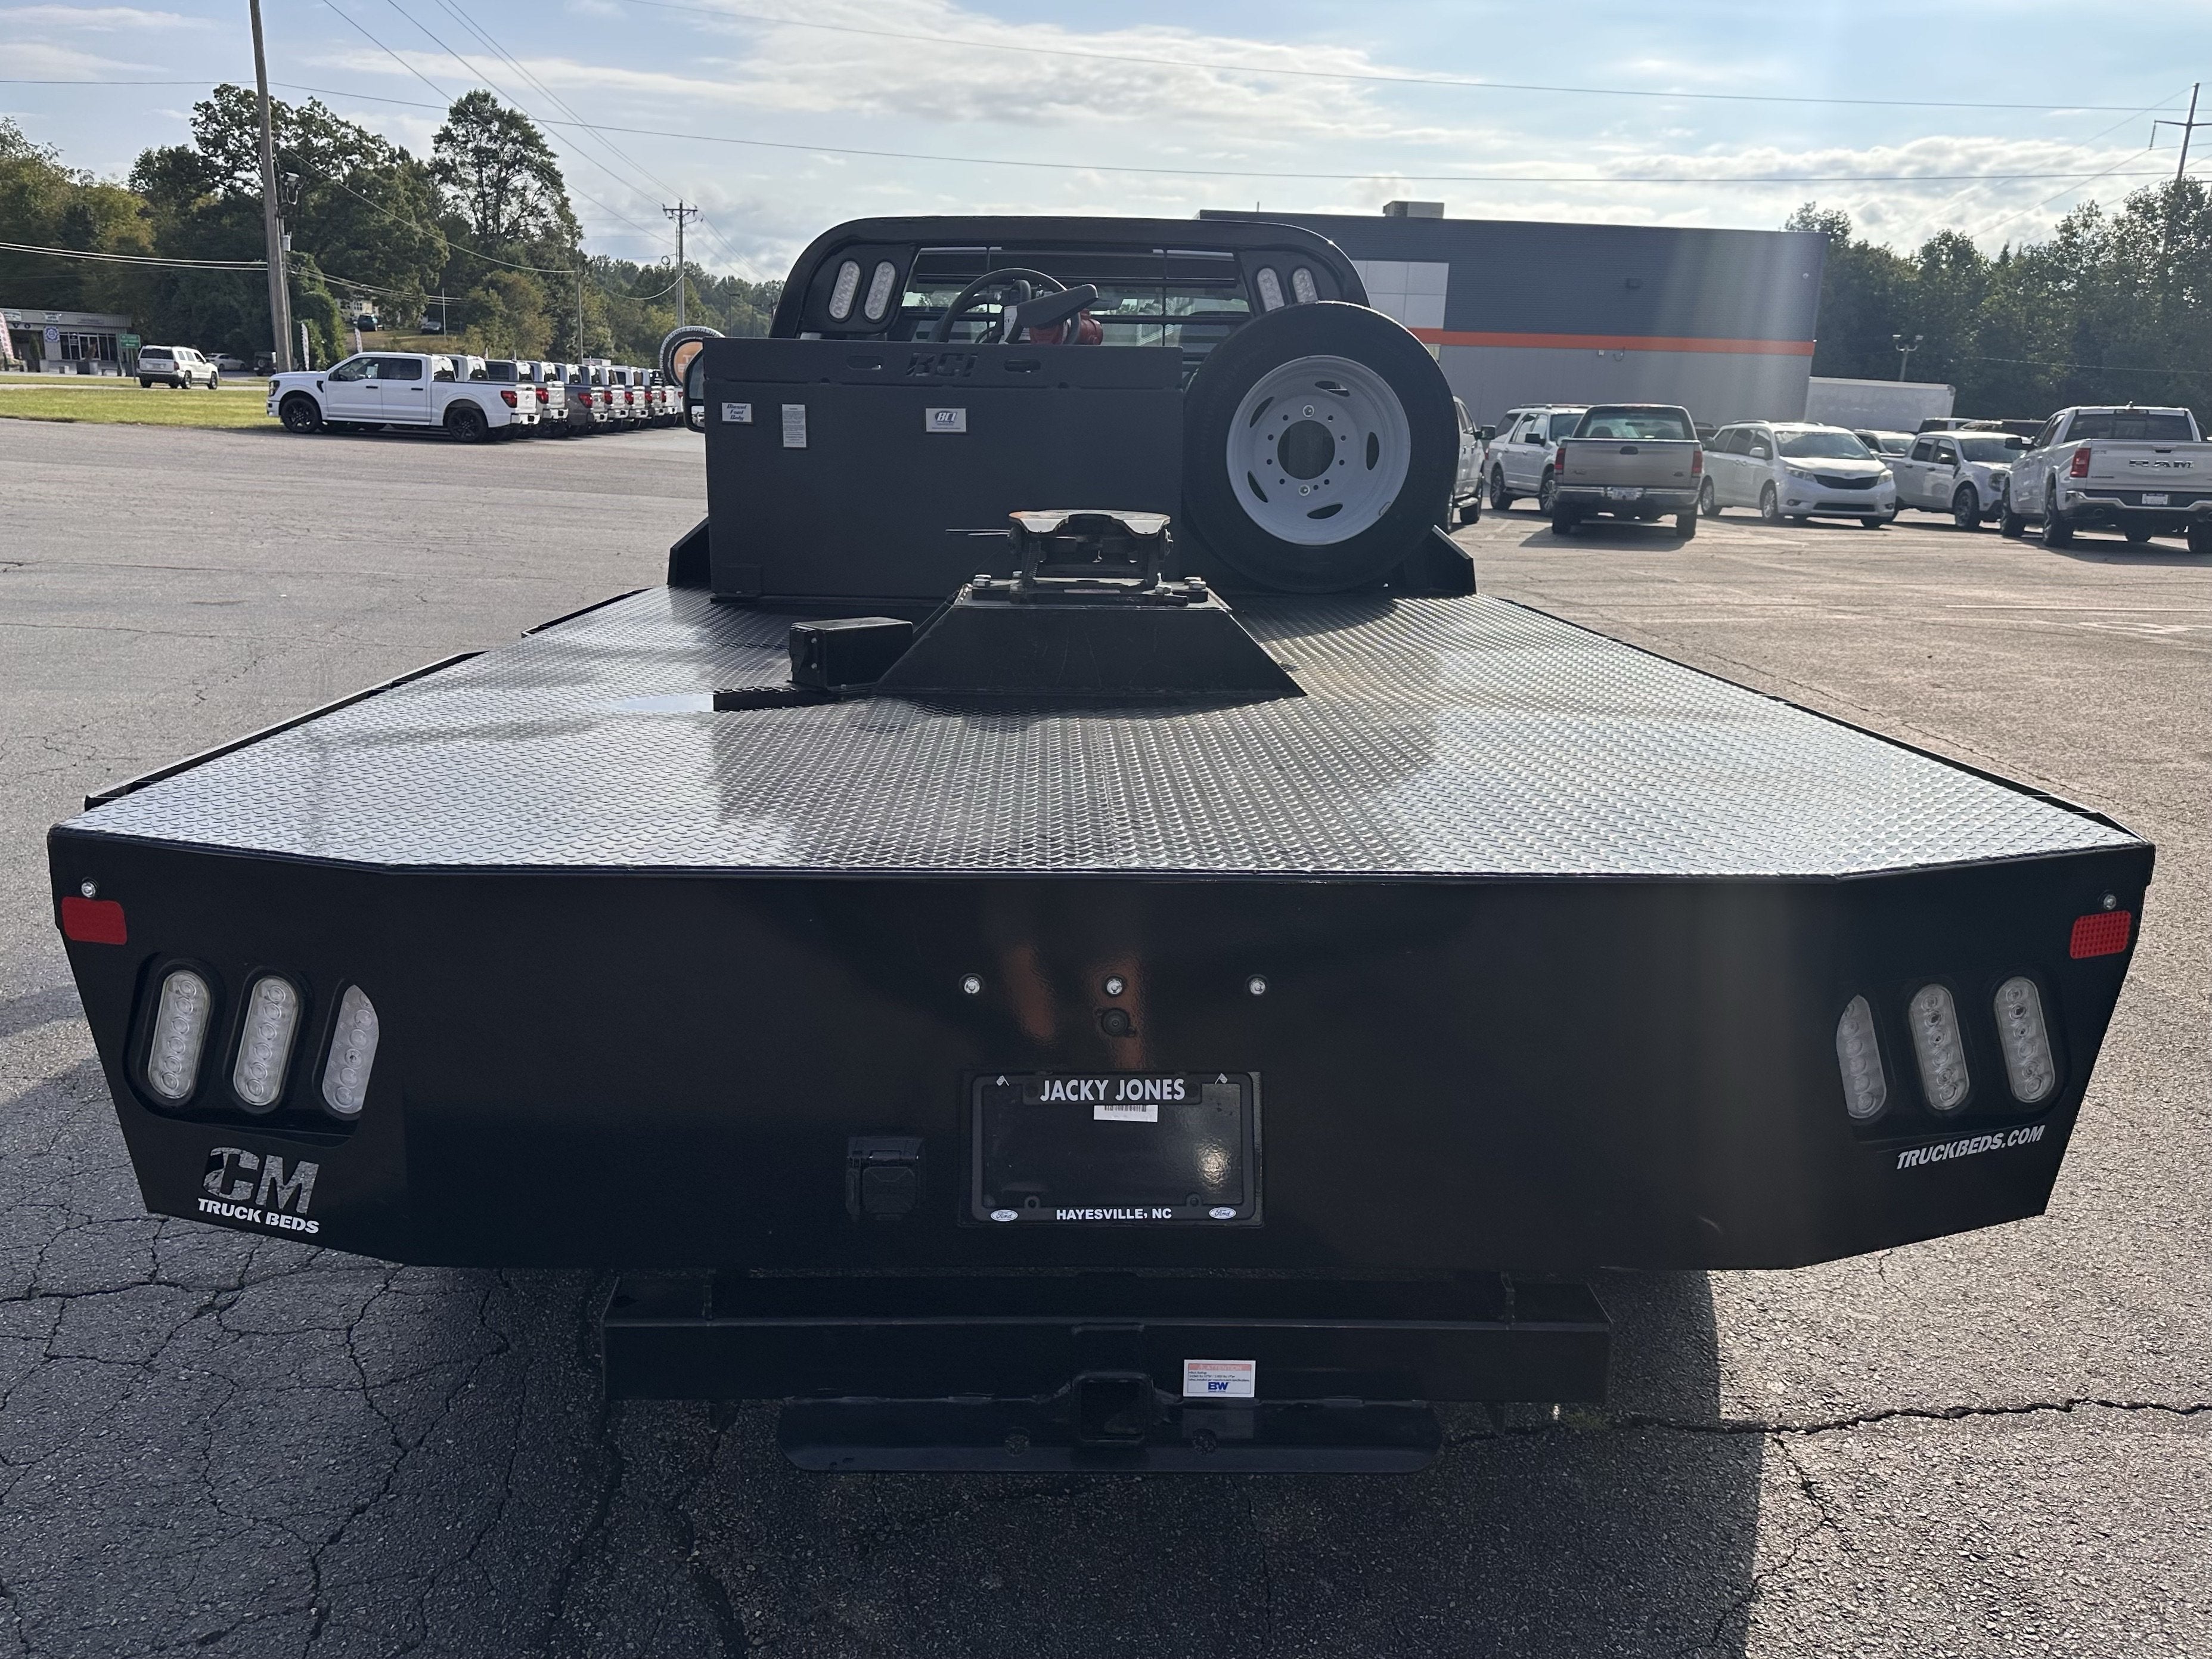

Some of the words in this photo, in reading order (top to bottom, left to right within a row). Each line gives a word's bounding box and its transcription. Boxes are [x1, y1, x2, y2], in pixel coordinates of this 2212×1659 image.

[906, 352, 978, 377] BCI
[2129, 459, 2195, 469] RAM
[1040, 1080, 1109, 1102] JACKY
[1115, 1078, 1186, 1101] JONES
[1897, 1125, 2046, 1170] TRUCKBEDS.COM
[203, 1147, 319, 1215] CM
[197, 1198, 262, 1223] TRUCK
[265, 1212, 320, 1234] BEDS
[1056, 1208, 1148, 1220] HAYESVILLE,
[1152, 1208, 1172, 1219] NC
